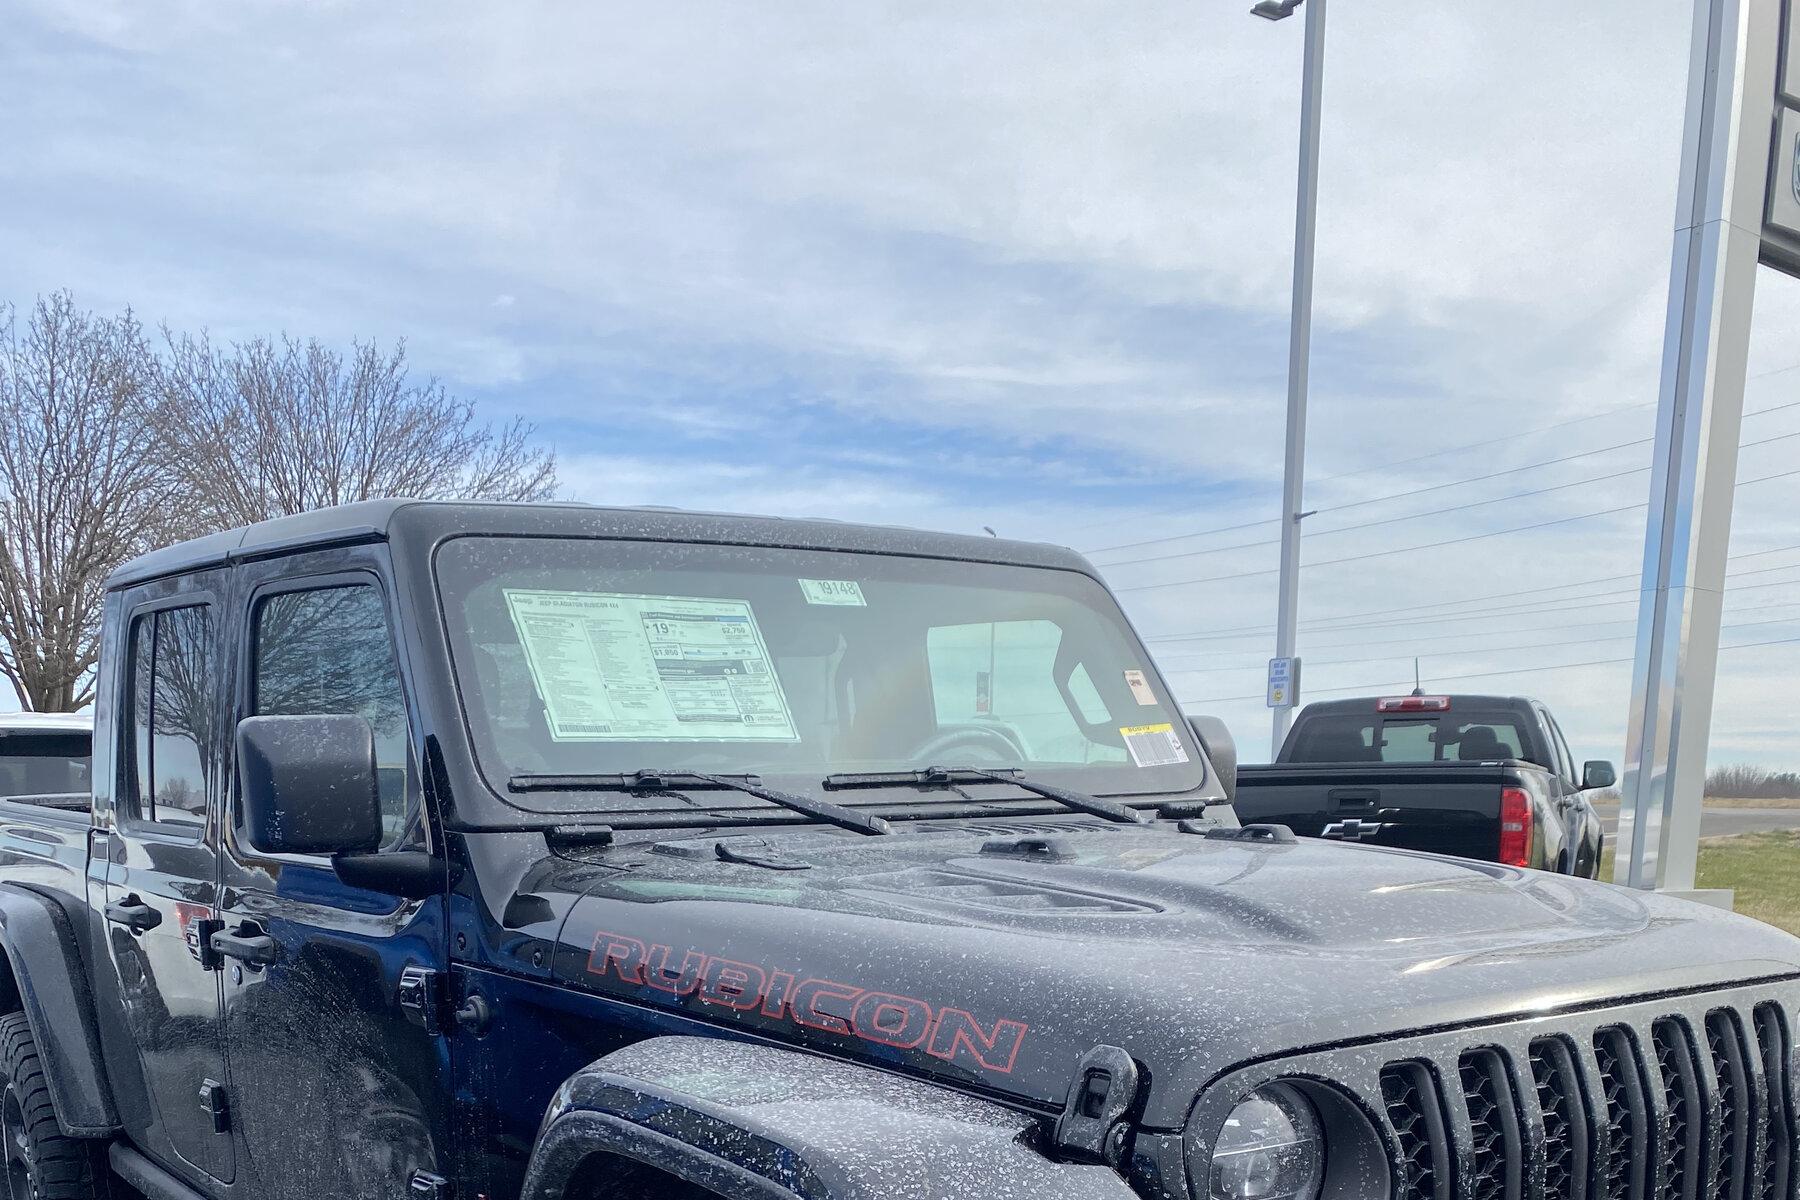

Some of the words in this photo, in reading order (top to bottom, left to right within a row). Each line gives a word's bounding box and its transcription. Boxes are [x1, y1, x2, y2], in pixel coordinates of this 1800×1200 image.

[819, 581, 856, 595] 19148
[652, 622, 669, 634] 19
[587, 931, 1028, 1074] RUBICON
